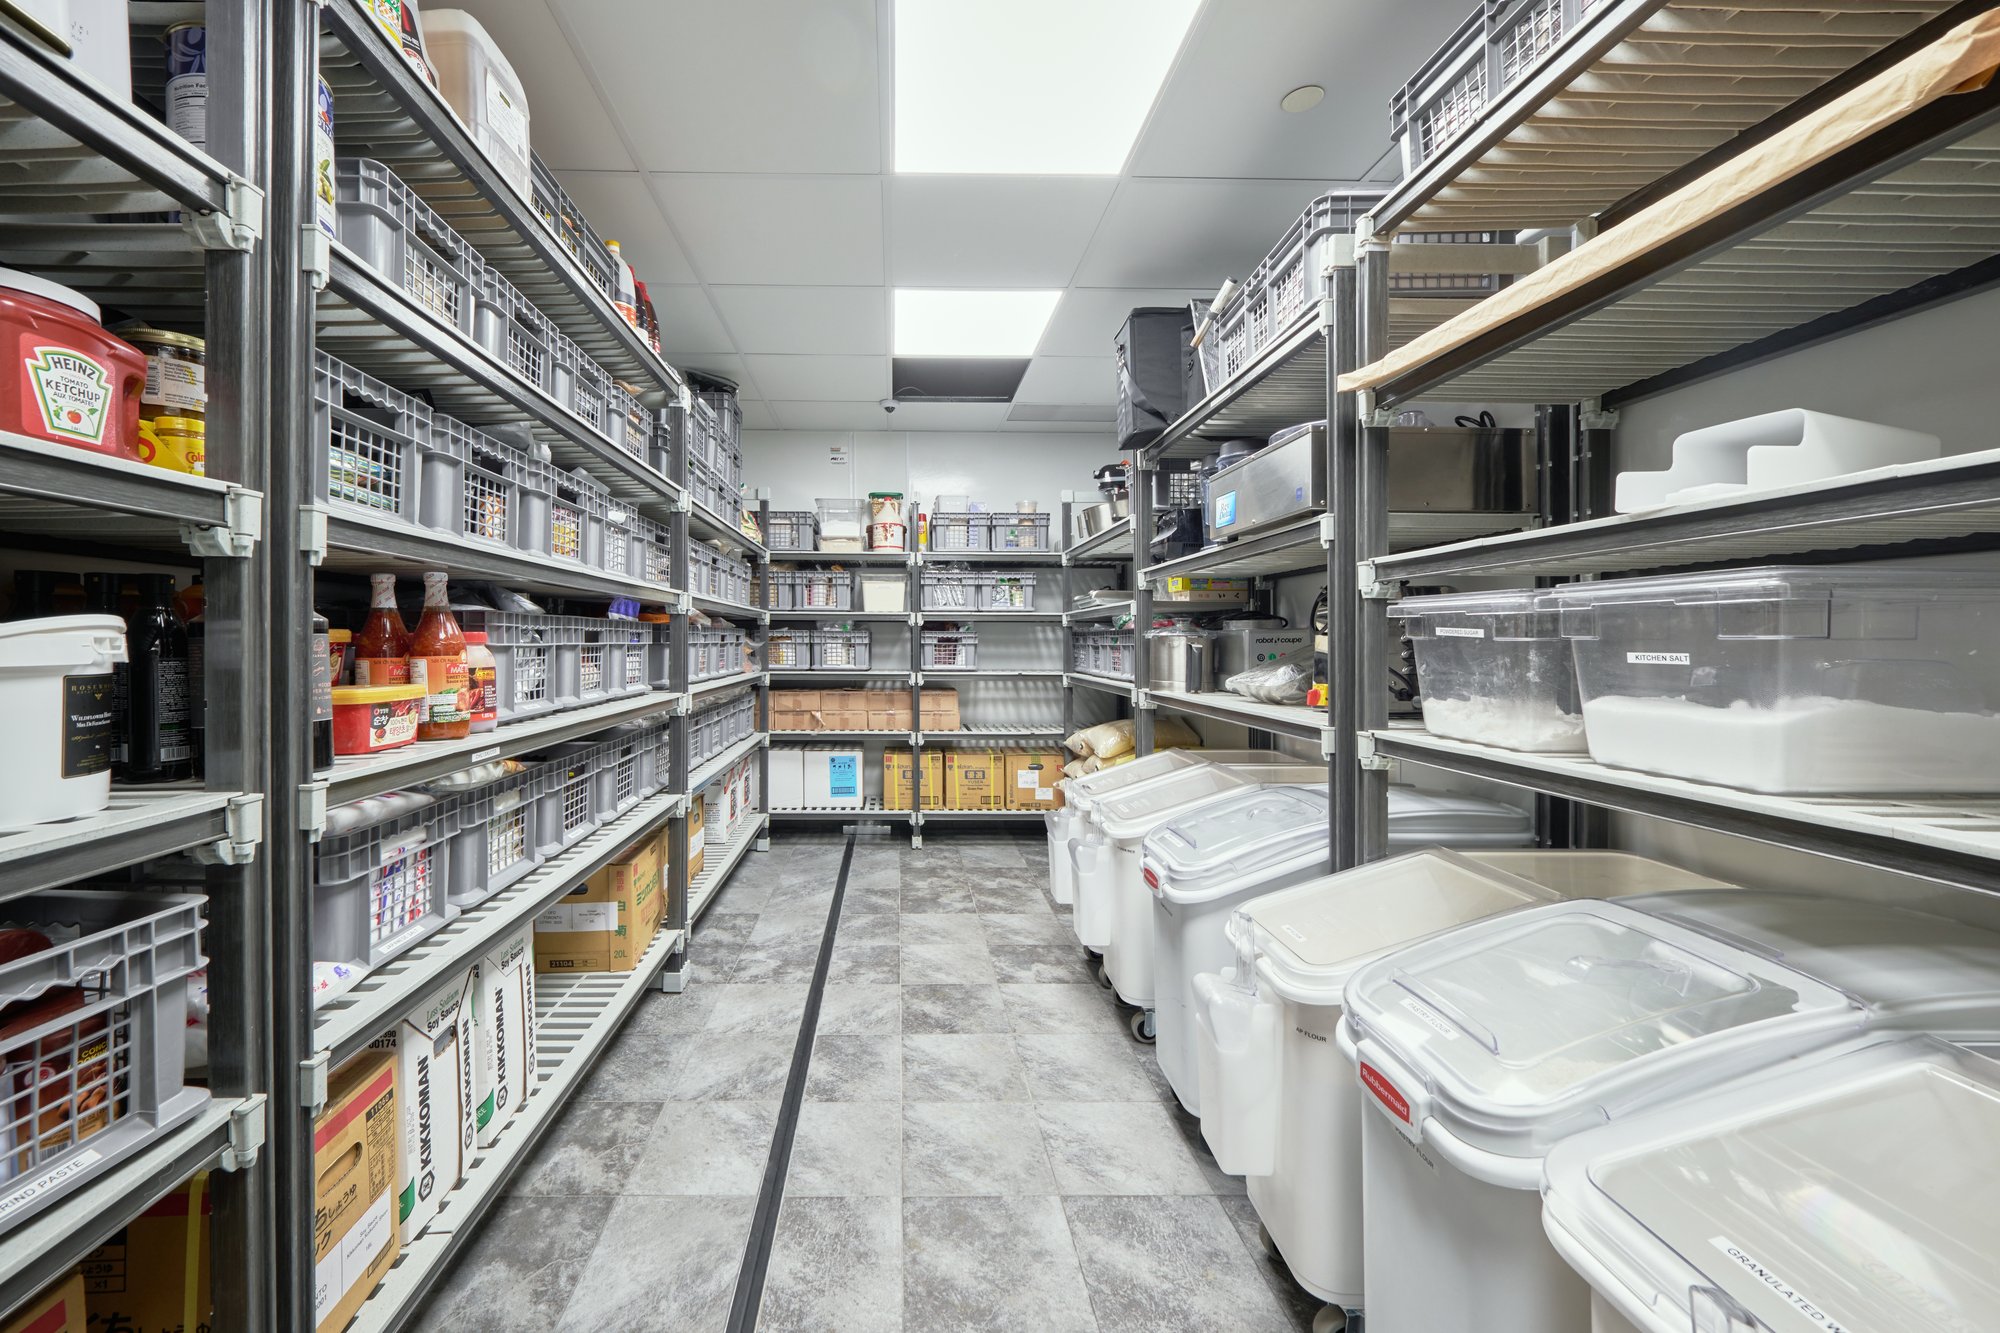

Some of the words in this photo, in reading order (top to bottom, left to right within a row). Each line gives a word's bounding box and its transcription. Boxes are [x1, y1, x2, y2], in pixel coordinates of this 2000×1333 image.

[50, 356, 96, 380] HEINZ
[60, 376, 88, 388] TOMATO
[46, 379, 100, 402] KETCHUP
[69, 395, 94, 407] TOMATES
[501, 958, 510, 970] Soy
[510, 946, 524, 962] Sauce
[614, 950, 628, 959] 20L
[427, 1017, 439, 1032] Soy
[440, 1000, 459, 1021] Sauce
[526, 964, 534, 1051] KIKKOMAN
[1408, 1002, 1429, 1018] PASTRY
[1430, 1018, 1451, 1032] FLOUR
[495, 987, 506, 1085] KIKKOMAN
[1304, 1031, 1326, 1042] FLOUR
[463, 1018, 472, 1122] KIKKOMAN
[1362, 1068, 1408, 1116] Rubbermaid
[418, 1055, 431, 1172] KIKKOMAN
[1395, 1126, 1416, 1149] PASTRY
[1416, 1147, 1434, 1169] FLOUR
[38, 1160, 84, 1188] PASTE
[1727, 1248, 1825, 1321] GRANULATED
